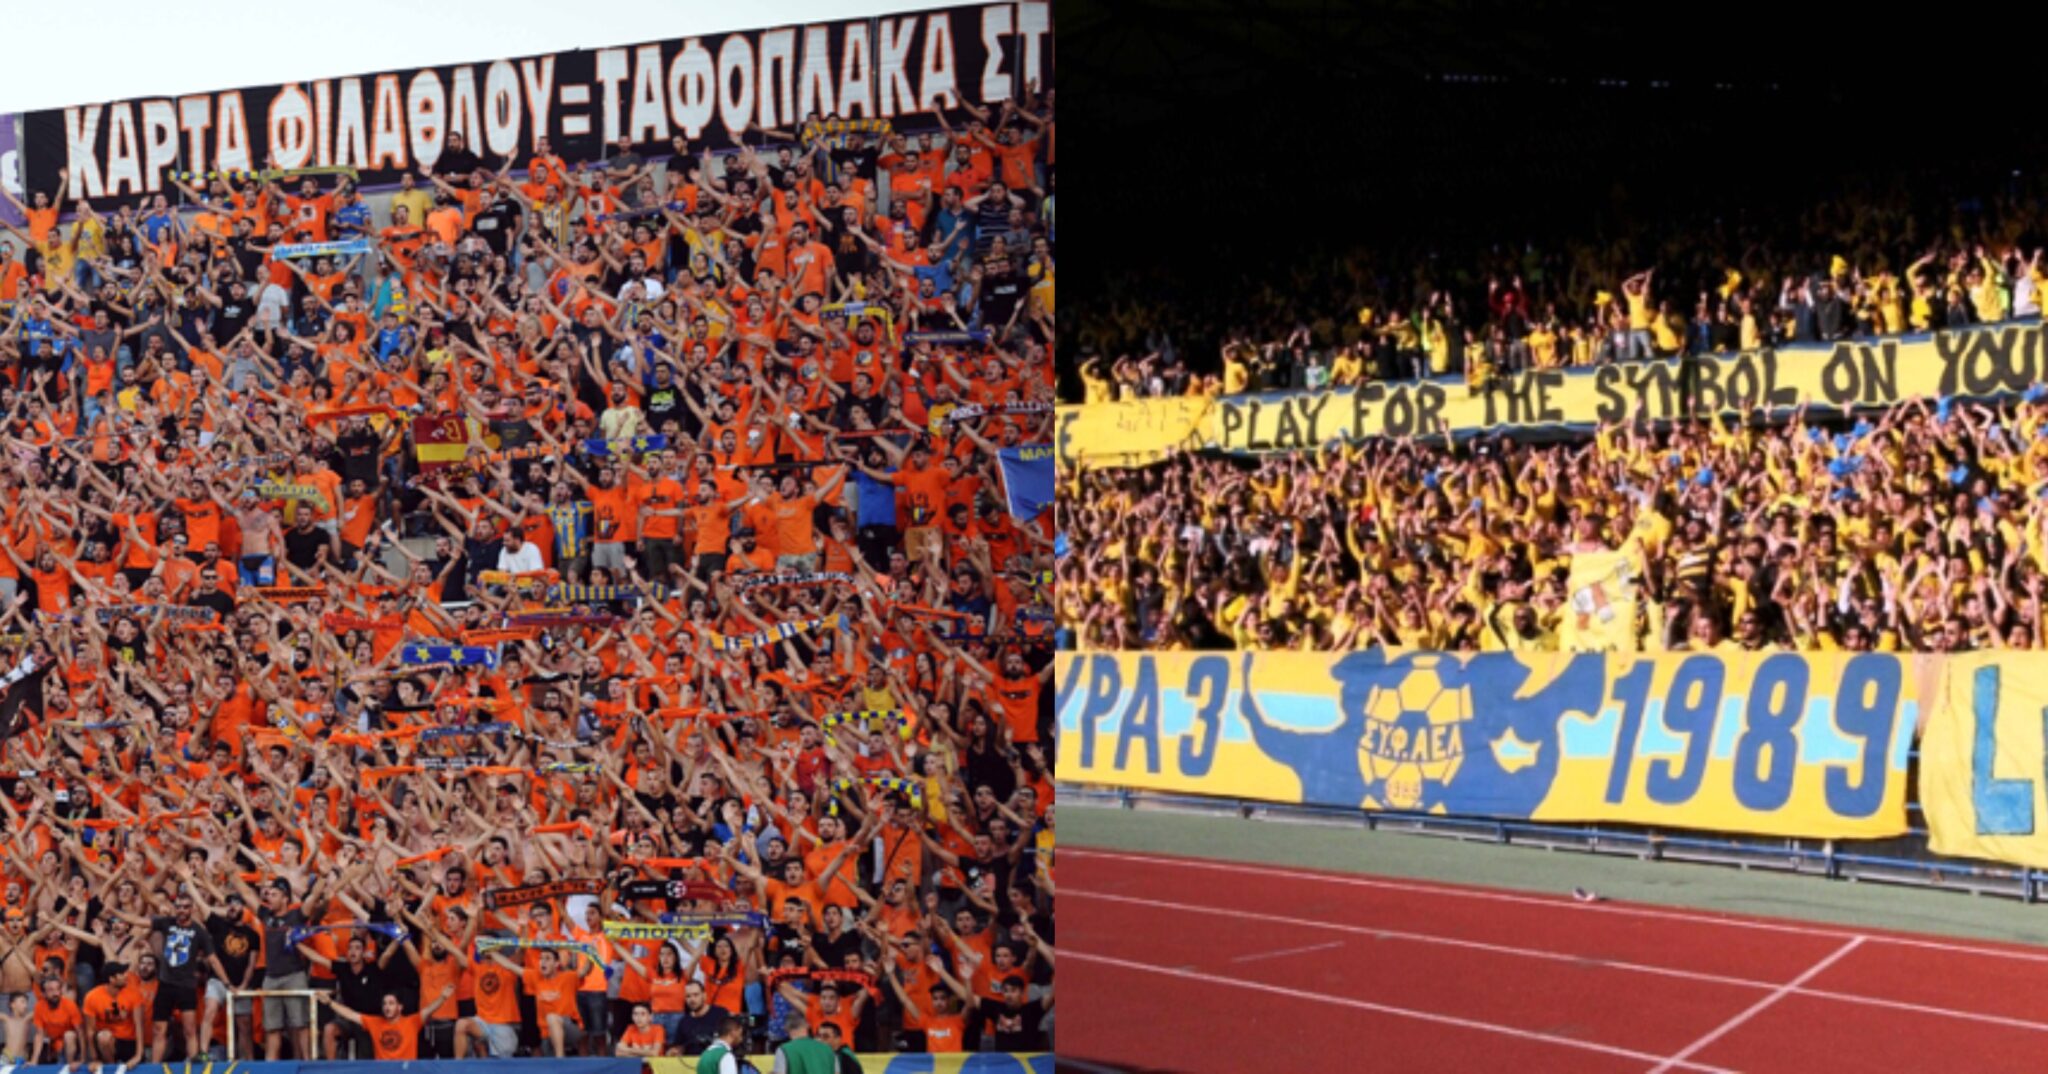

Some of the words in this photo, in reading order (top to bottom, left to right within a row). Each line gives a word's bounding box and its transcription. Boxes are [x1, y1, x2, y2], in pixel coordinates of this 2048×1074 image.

[64, 90, 253, 200] ΚΑΡΤΑ
[1222, 396, 1328, 450] PLAY
[1352, 382, 1447, 438] FOR
[1471, 370, 1564, 425] THE
[1596, 351, 1797, 429] SYMBOL
[1822, 341, 1898, 404] ON
[1936, 323, 2048, 396] YOU
[1178, 655, 1229, 777] 3
[1605, 653, 1902, 818] 1989
